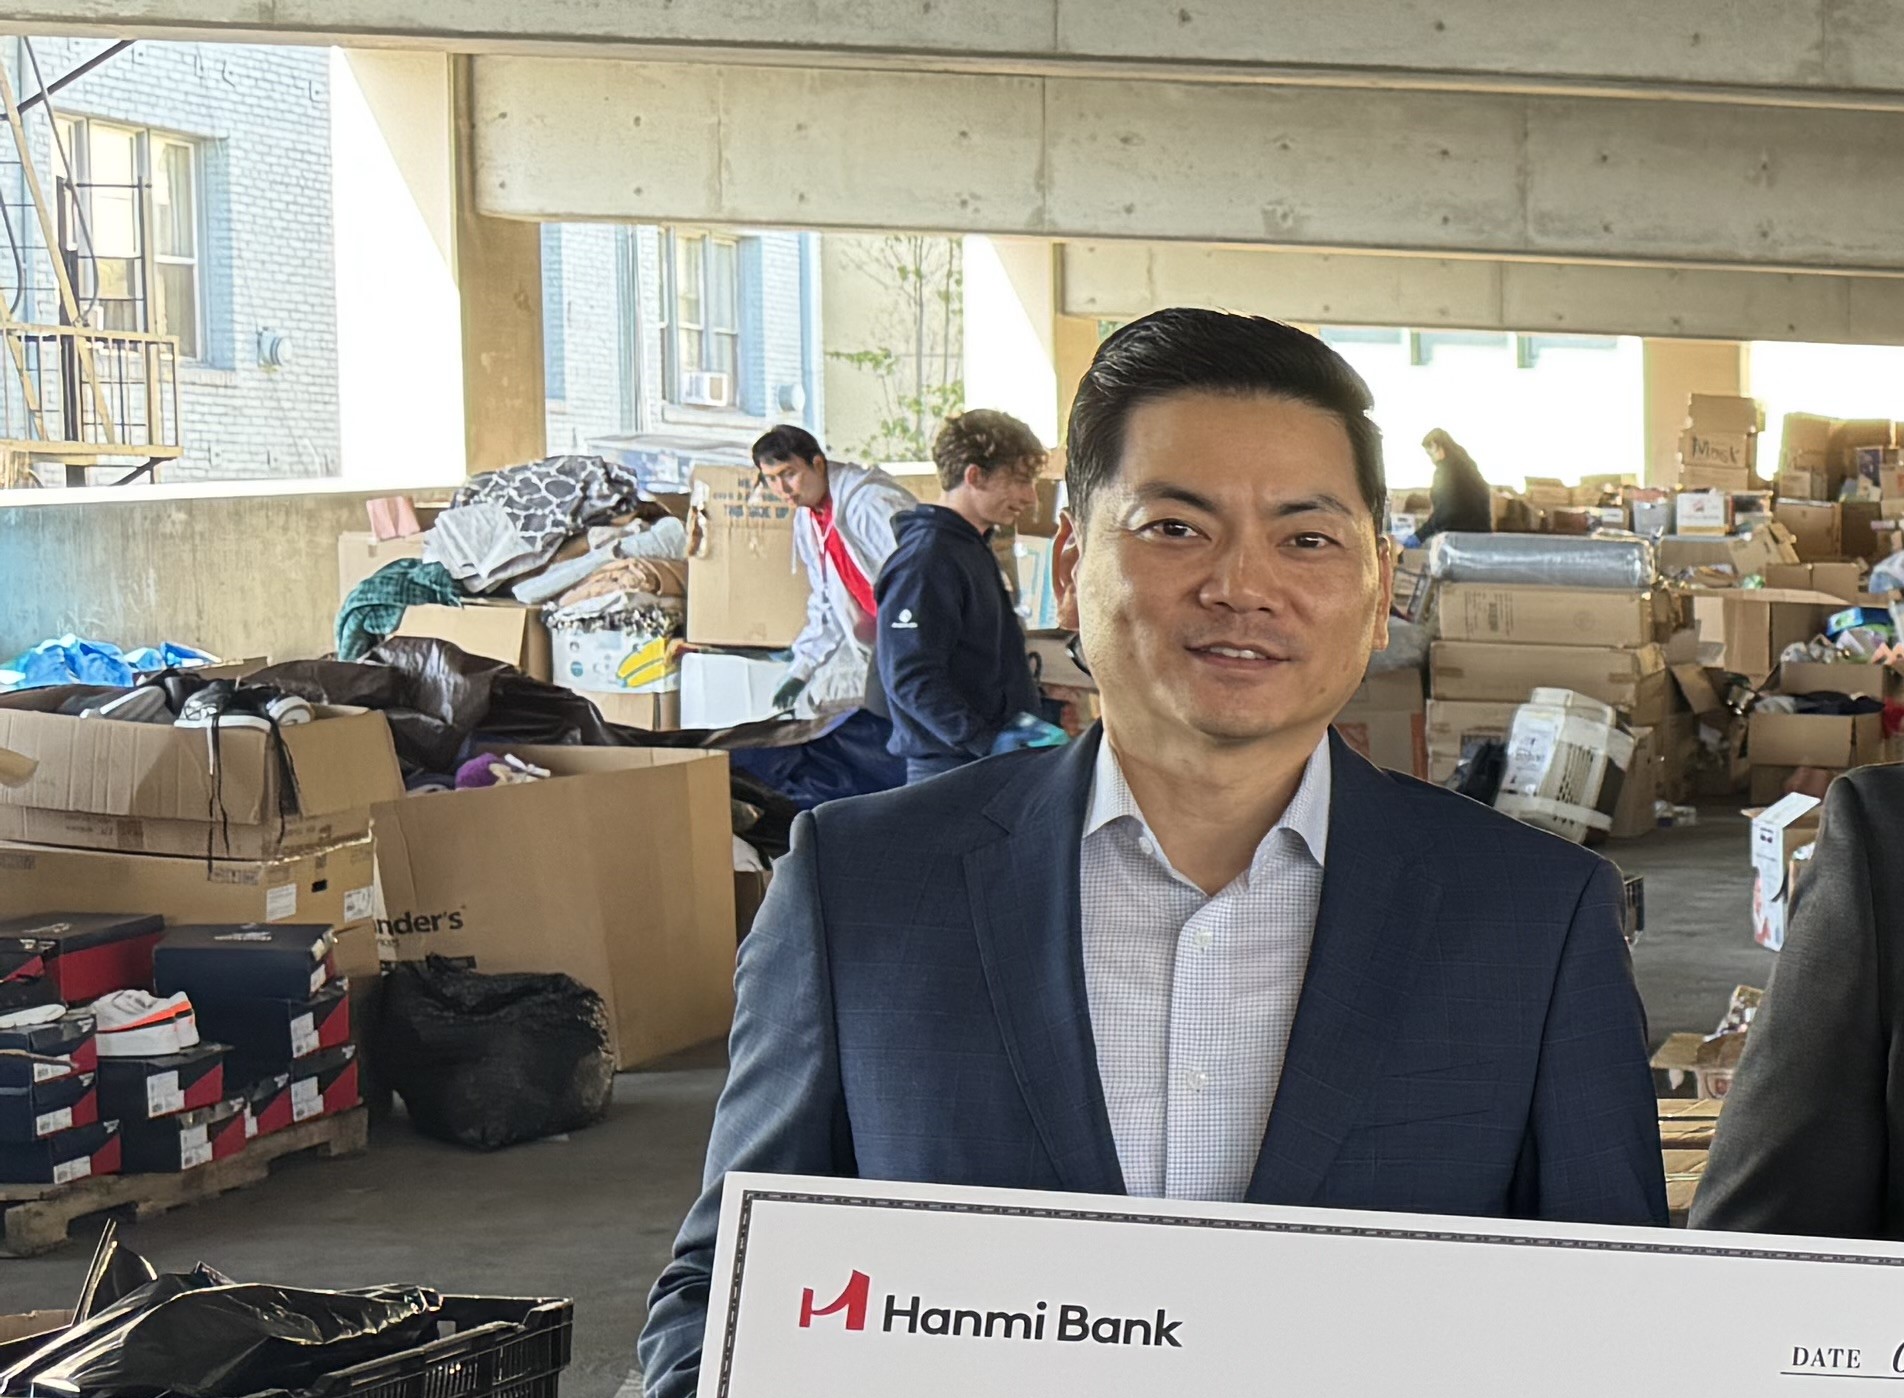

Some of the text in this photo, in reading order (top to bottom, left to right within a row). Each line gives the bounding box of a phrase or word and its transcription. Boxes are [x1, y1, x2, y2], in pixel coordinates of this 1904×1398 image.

[882, 1294, 1183, 1348] Hanmi Bank
[1791, 1345, 1862, 1370] DATE
